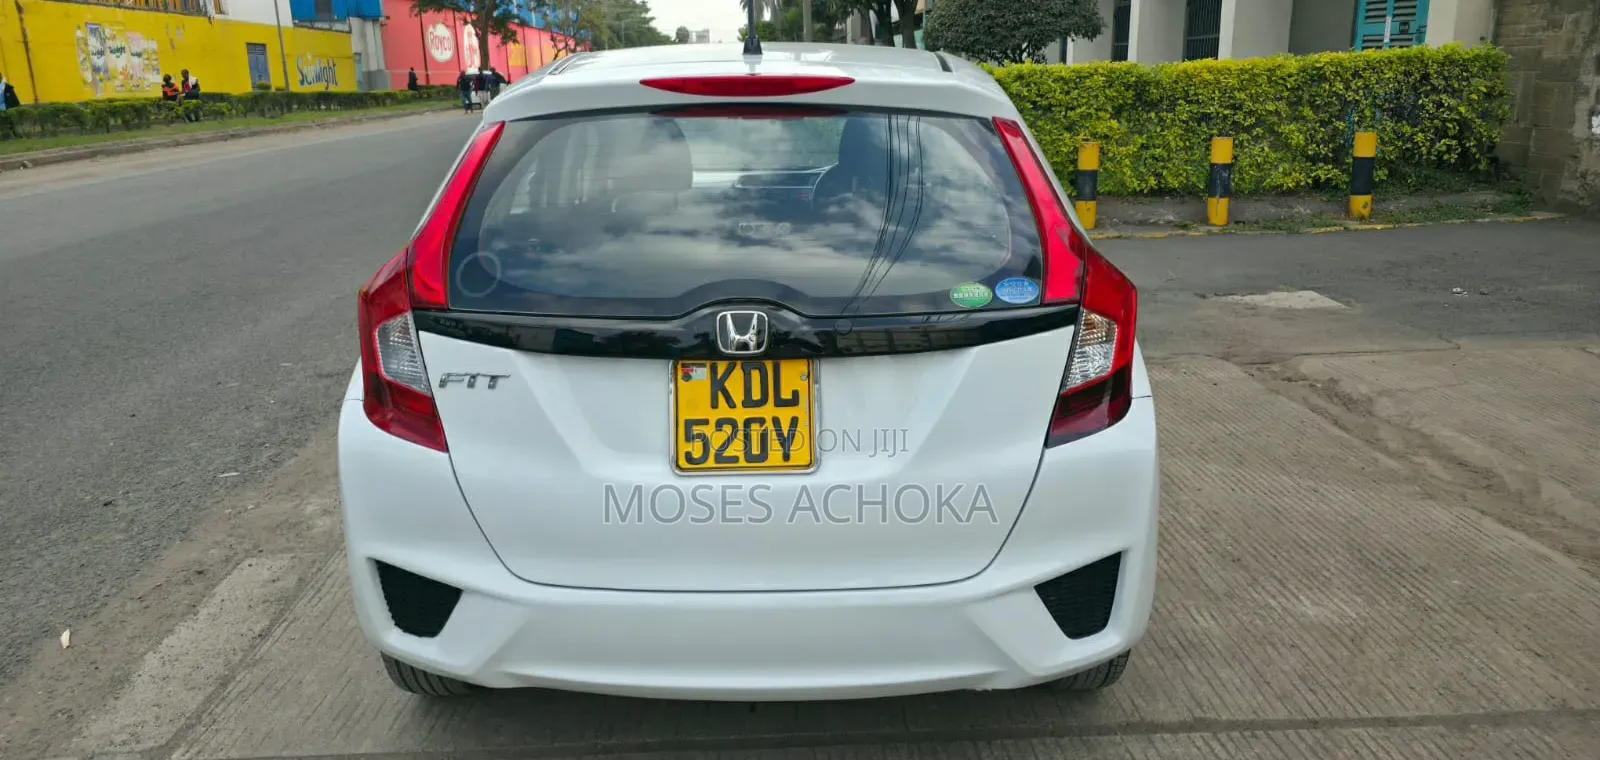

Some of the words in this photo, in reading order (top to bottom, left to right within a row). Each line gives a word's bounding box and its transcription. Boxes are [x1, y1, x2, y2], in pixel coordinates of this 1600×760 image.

[429, 32, 452, 54] Royco
[297, 56, 338, 90] Sunlight
[438, 372, 512, 389] FIT
[710, 361, 800, 410] KDL
[684, 416, 800, 466] 520Y
